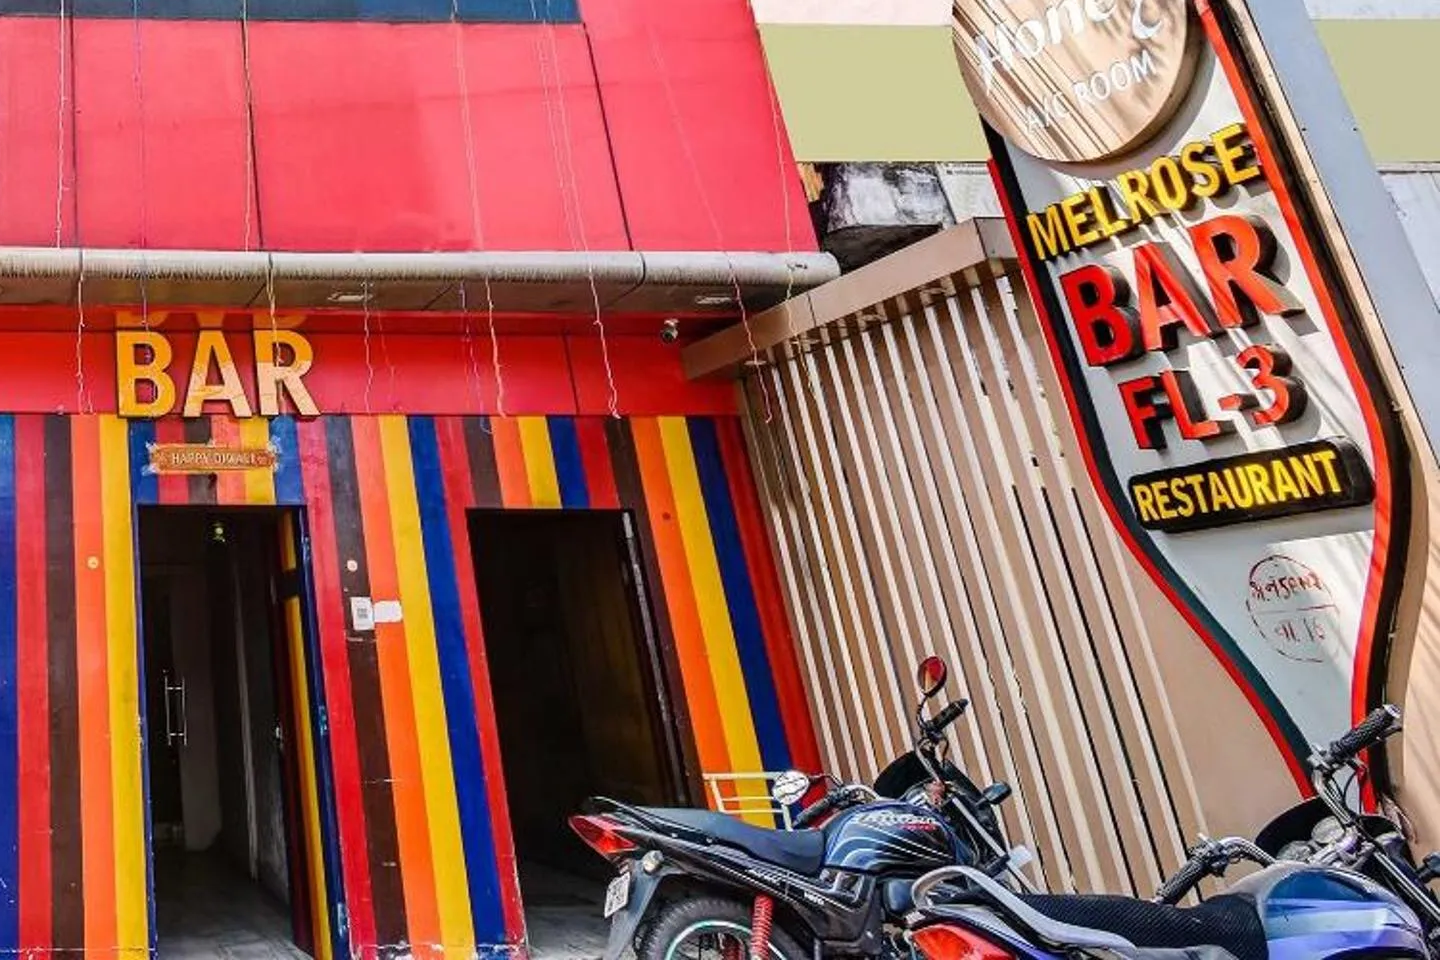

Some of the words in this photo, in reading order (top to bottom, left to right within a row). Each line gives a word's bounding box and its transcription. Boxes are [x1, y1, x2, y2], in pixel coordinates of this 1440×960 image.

[1071, 49, 1158, 108] ROOM
[1026, 123, 1260, 261] MELROSE
[1060, 214, 1290, 367] BAR
[116, 329, 321, 418] BAR
[1117, 344, 1292, 449] FL-3
[171, 452, 209, 465] HAPPY
[213, 451, 255, 464] DIWALI
[1132, 449, 1342, 522] RESTAURANT
